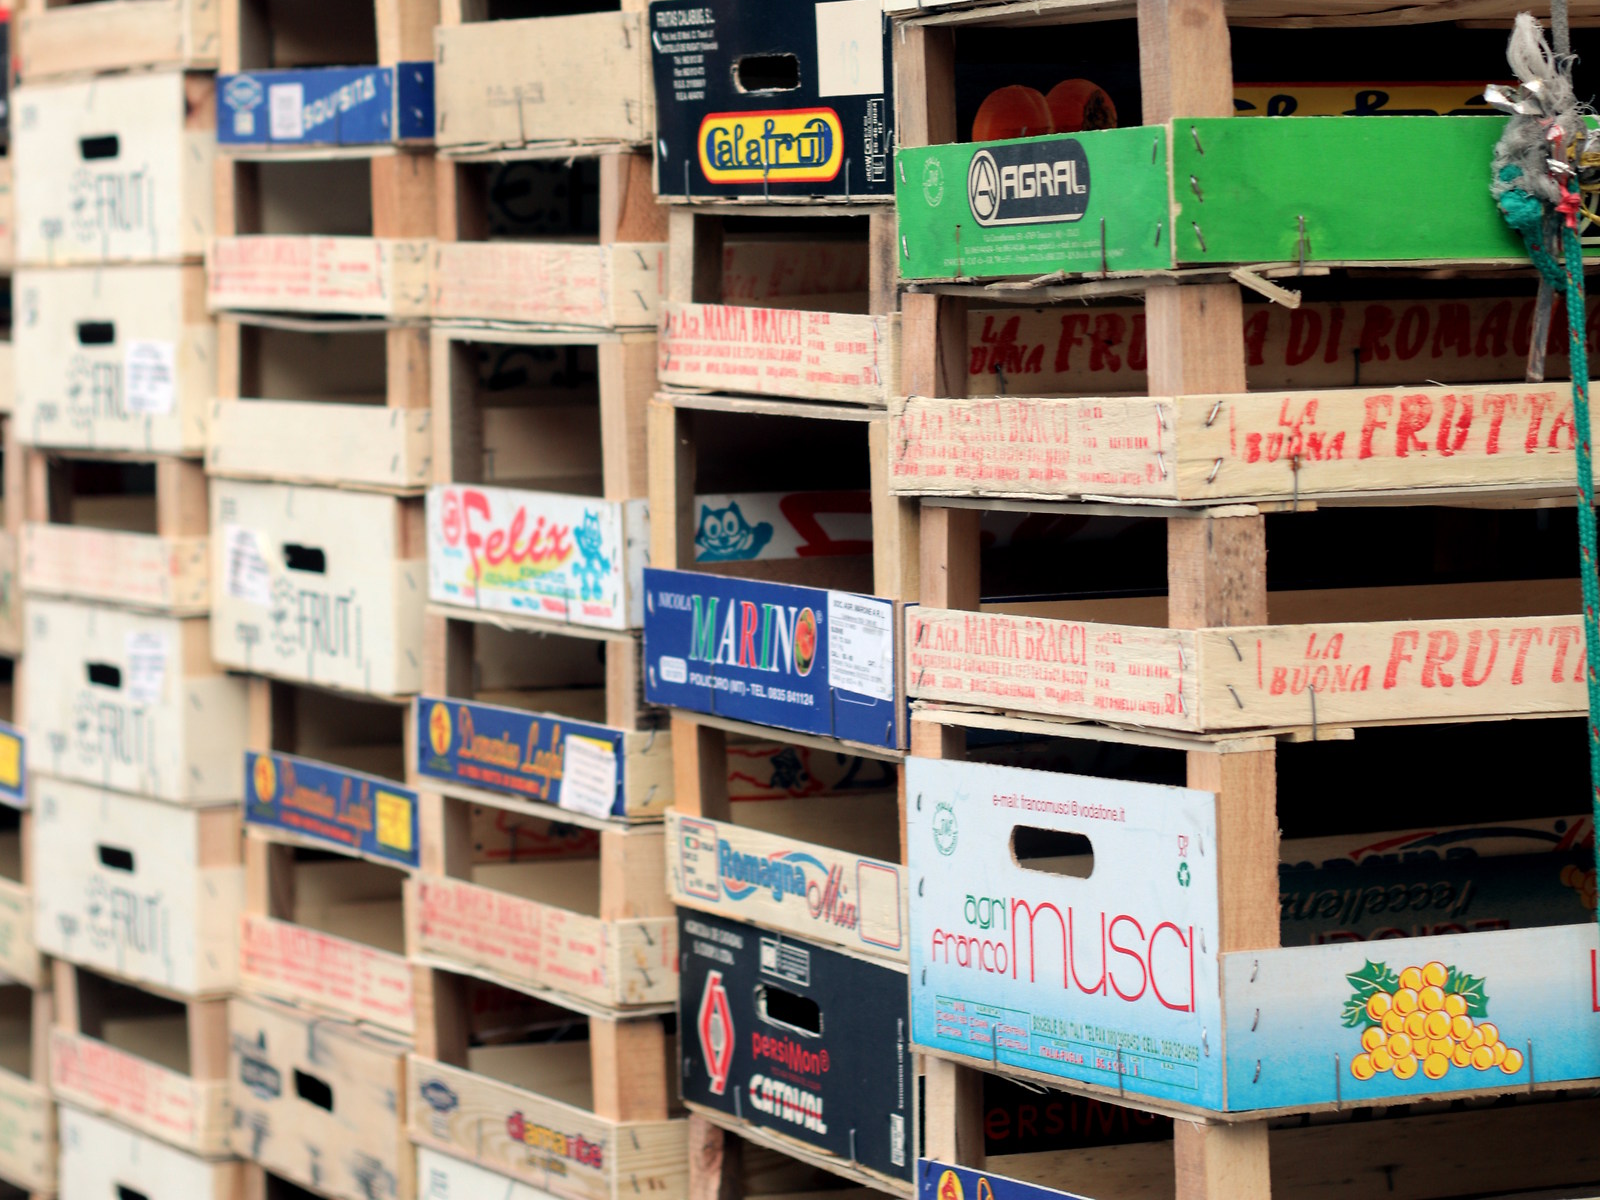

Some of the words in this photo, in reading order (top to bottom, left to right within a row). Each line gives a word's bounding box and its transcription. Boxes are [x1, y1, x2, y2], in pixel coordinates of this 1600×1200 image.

[1001, 159, 1083, 200] AGRAL
[1285, 307, 1345, 366] DI
[1279, 398, 1319, 427] LA
[1245, 431, 1345, 464] BUONA
[462, 489, 573, 582] Felix
[688, 594, 818, 678] MARINO
[1025, 620, 1087, 667] BRACCI
[1305, 632, 1344, 660] LA
[1269, 664, 1371, 696] BUONA
[718, 838, 807, 903] Romagna
[964, 894, 1007, 931] agri
[932, 928, 1009, 975] franco
[749, 1073, 828, 1136] CATAVAL
